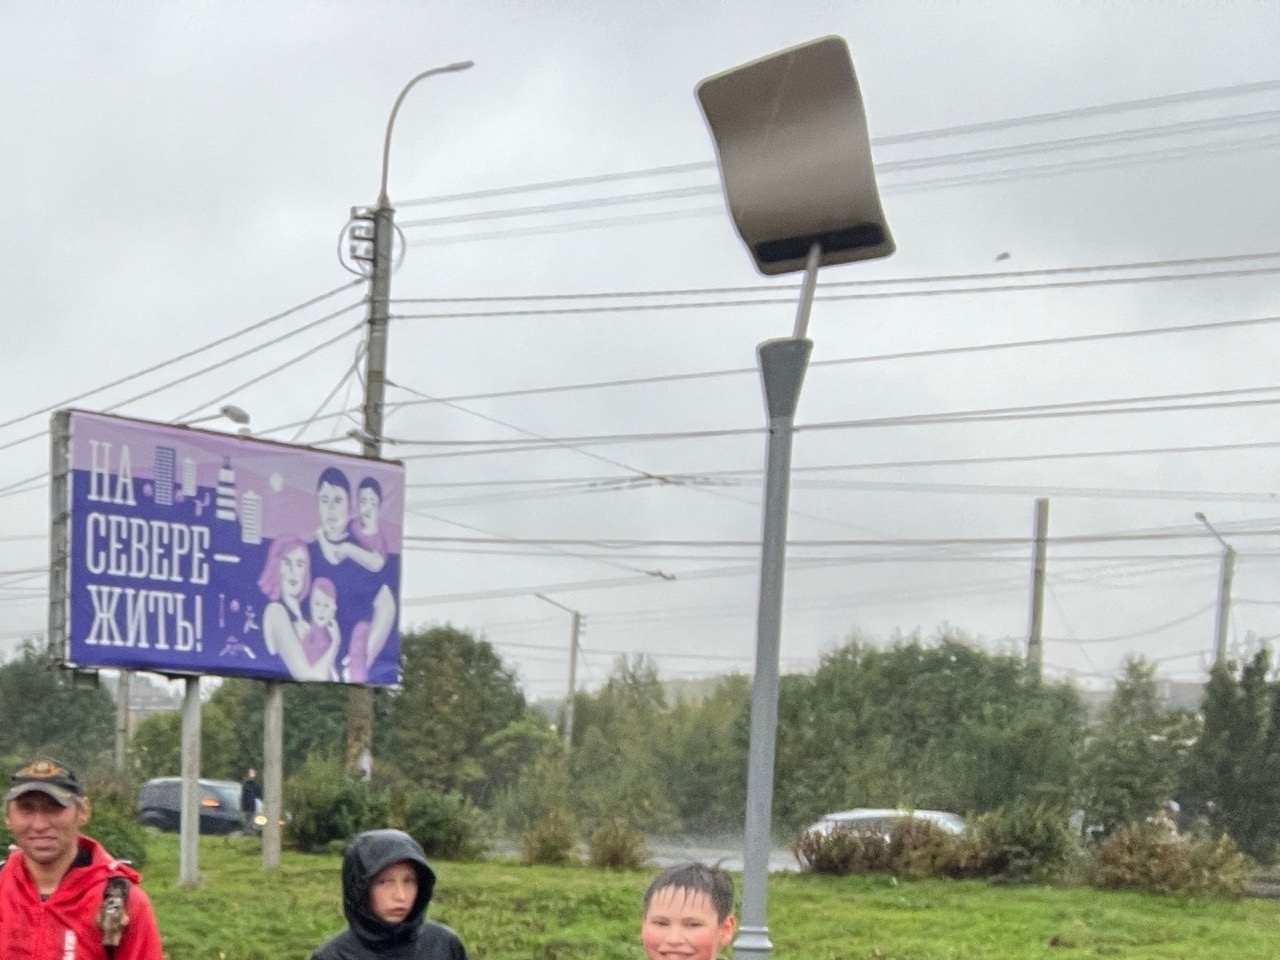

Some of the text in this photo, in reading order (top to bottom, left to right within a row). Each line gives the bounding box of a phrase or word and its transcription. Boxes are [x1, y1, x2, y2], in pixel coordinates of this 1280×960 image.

[87, 439, 138, 506] НА
[85, 511, 211, 585] СЕВЕРЕ
[84, 584, 204, 653] ЖИТЬ!
